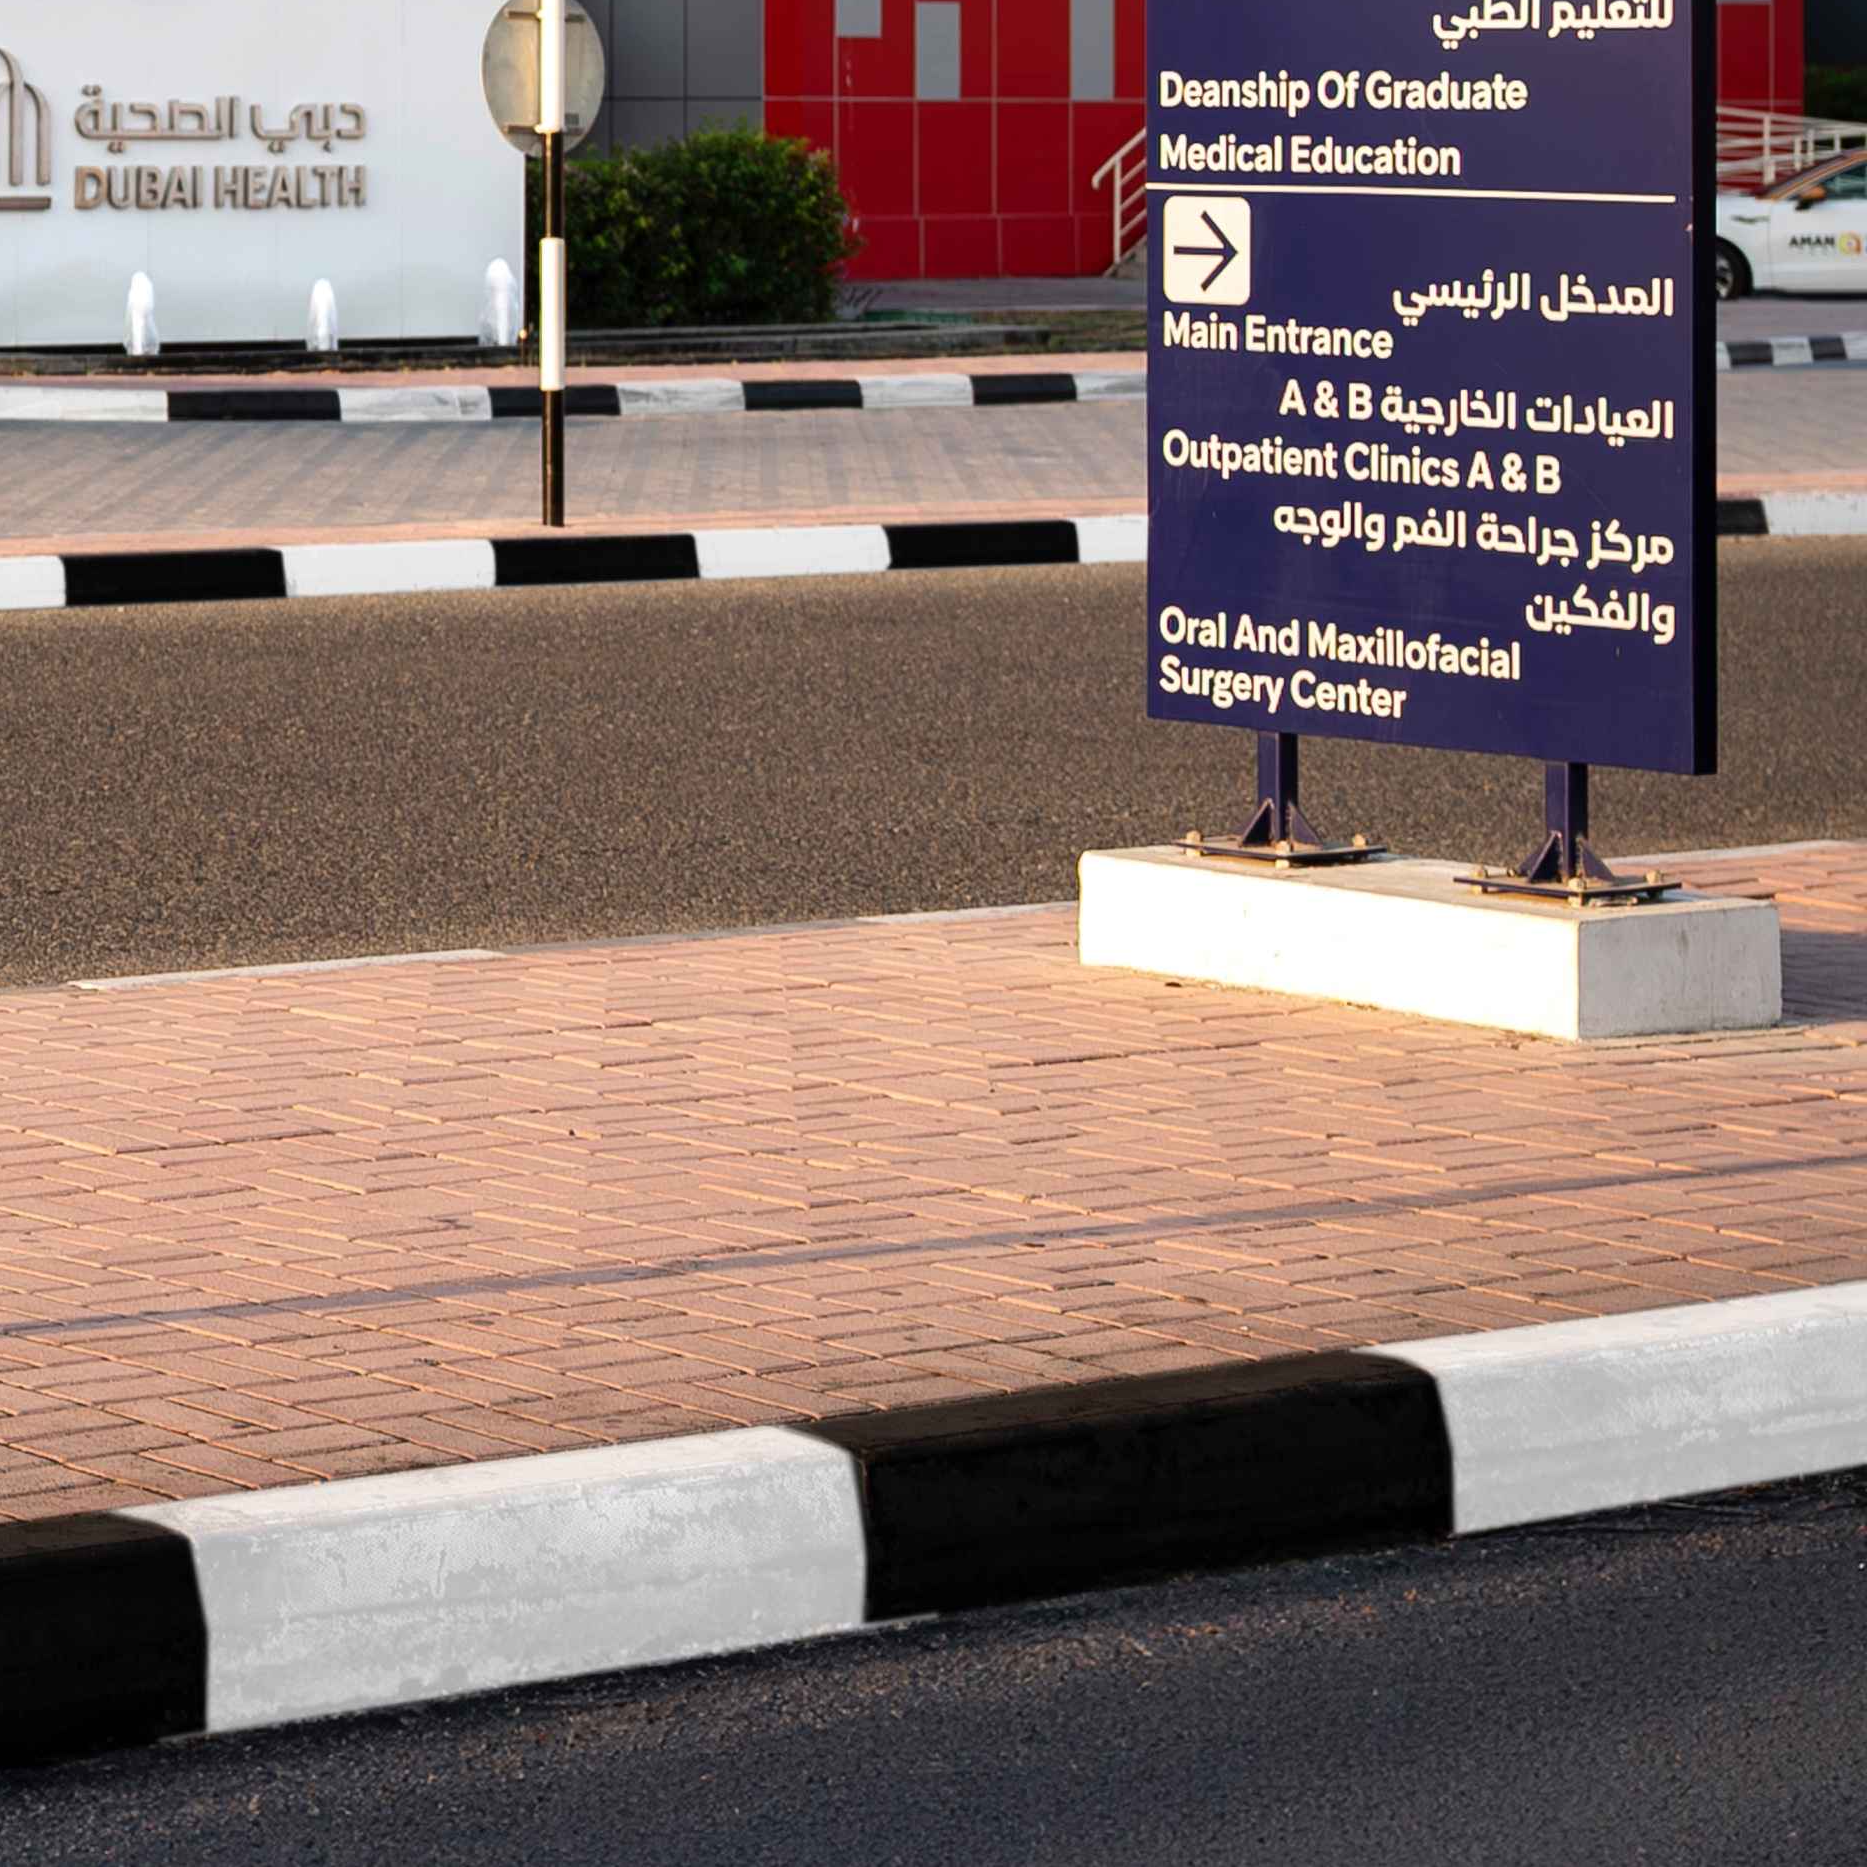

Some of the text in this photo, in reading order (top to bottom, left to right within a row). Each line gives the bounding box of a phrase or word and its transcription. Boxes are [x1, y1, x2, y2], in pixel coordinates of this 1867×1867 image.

[74, 84, 366, 154] دبي الصحية
[1159, 69, 1529, 118] Deanship Of Graduate
[1159, 133, 1462, 176] Medical Education
[74, 165, 367, 211] DUBAI HEALTH
[1391, 268, 1675, 327] المدخل الرئيسي
[1162, 311, 1395, 360] Main Entrance
[1278, 378, 1675, 448] العيادات الخارجية A & B
[1162, 428, 1562, 495] Outpatient Clinics A & B
[1273, 501, 1675, 573] مركز جراحة الفم والوجه
[1159, 605, 1521, 681] Oral And Maxillofacial
[1525, 583, 1676, 645] والفكين
[1159, 654, 1407, 720] Surgery Center
